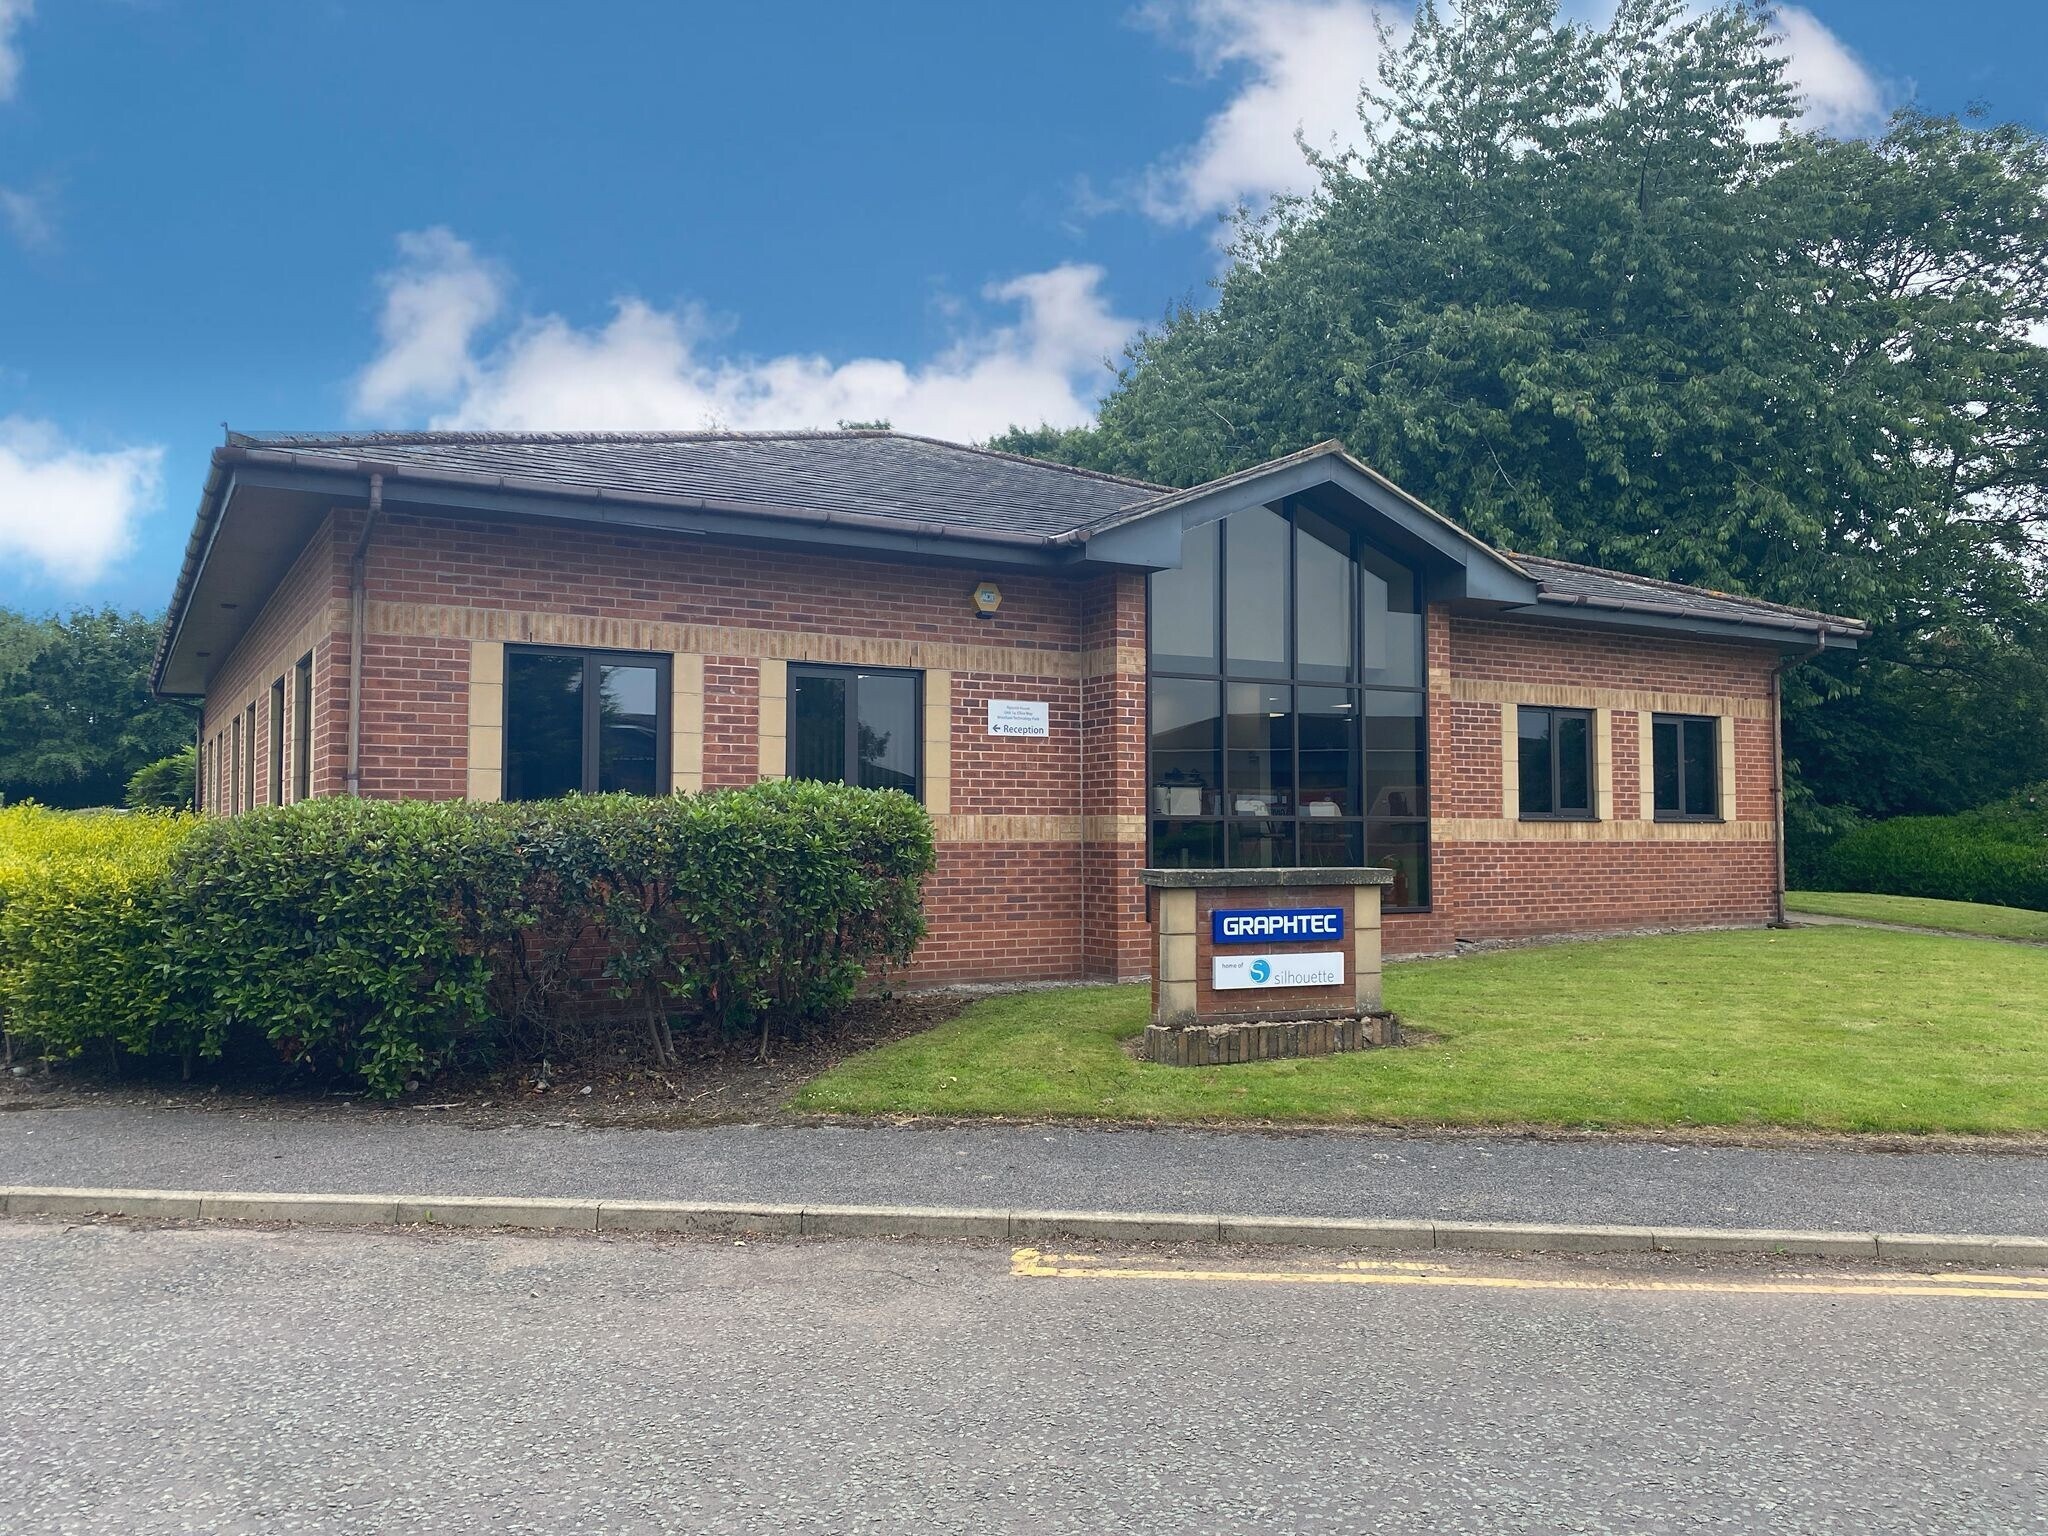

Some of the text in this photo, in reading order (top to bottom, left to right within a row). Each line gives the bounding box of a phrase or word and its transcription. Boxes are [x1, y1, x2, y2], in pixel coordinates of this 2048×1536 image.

[1003, 724, 1044, 735] Reception
[1223, 914, 1337, 936] GRAPHTEC
[1274, 970, 1334, 985] silhouette
